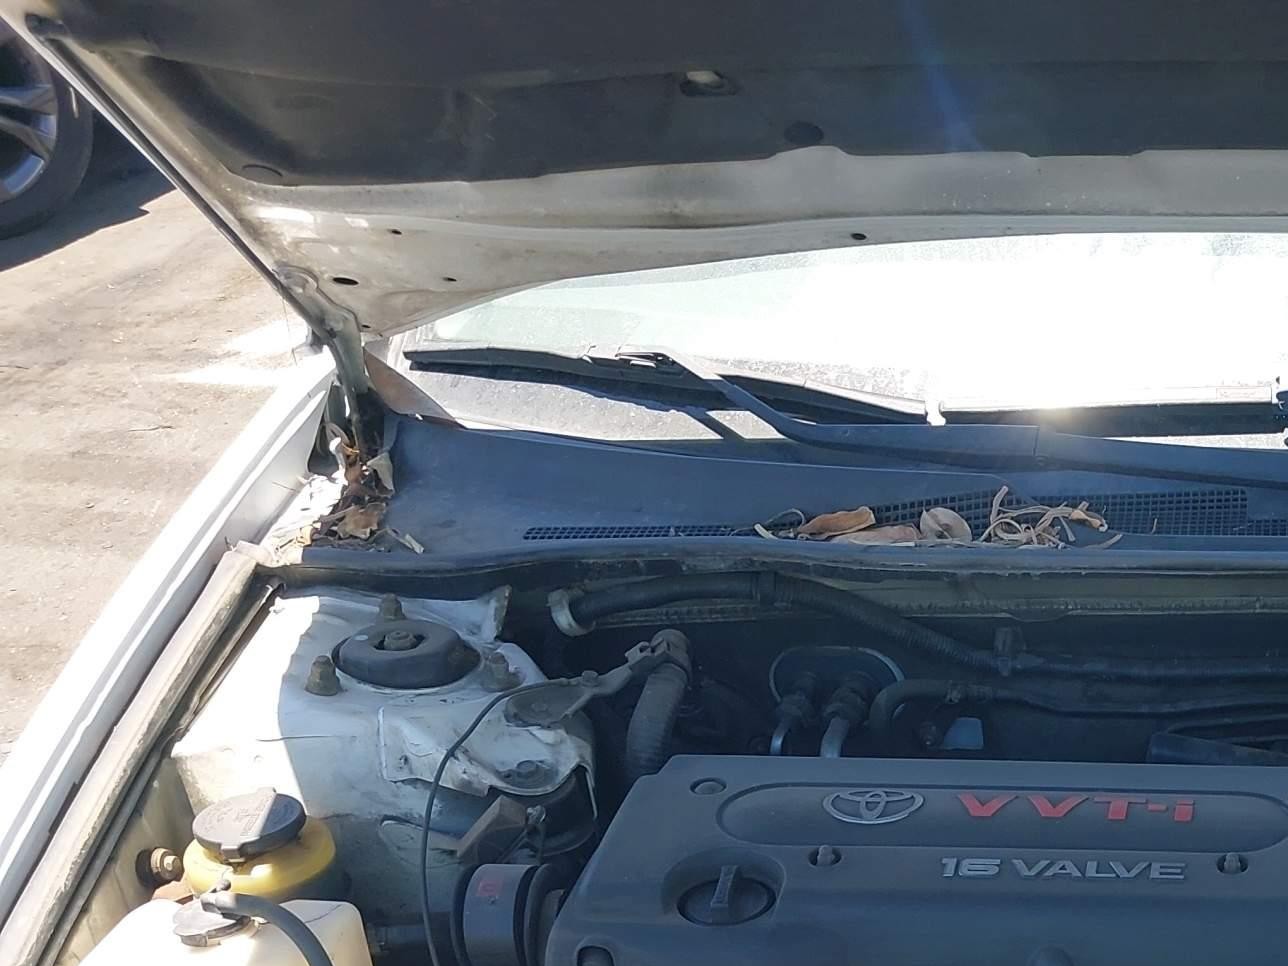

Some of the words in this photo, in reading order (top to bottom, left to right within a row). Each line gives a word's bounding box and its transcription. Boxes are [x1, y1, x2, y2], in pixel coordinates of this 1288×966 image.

[958, 792, 1195, 821] VVT-i
[941, 857, 1001, 877] 16
[1012, 859, 1187, 880] VALVE
